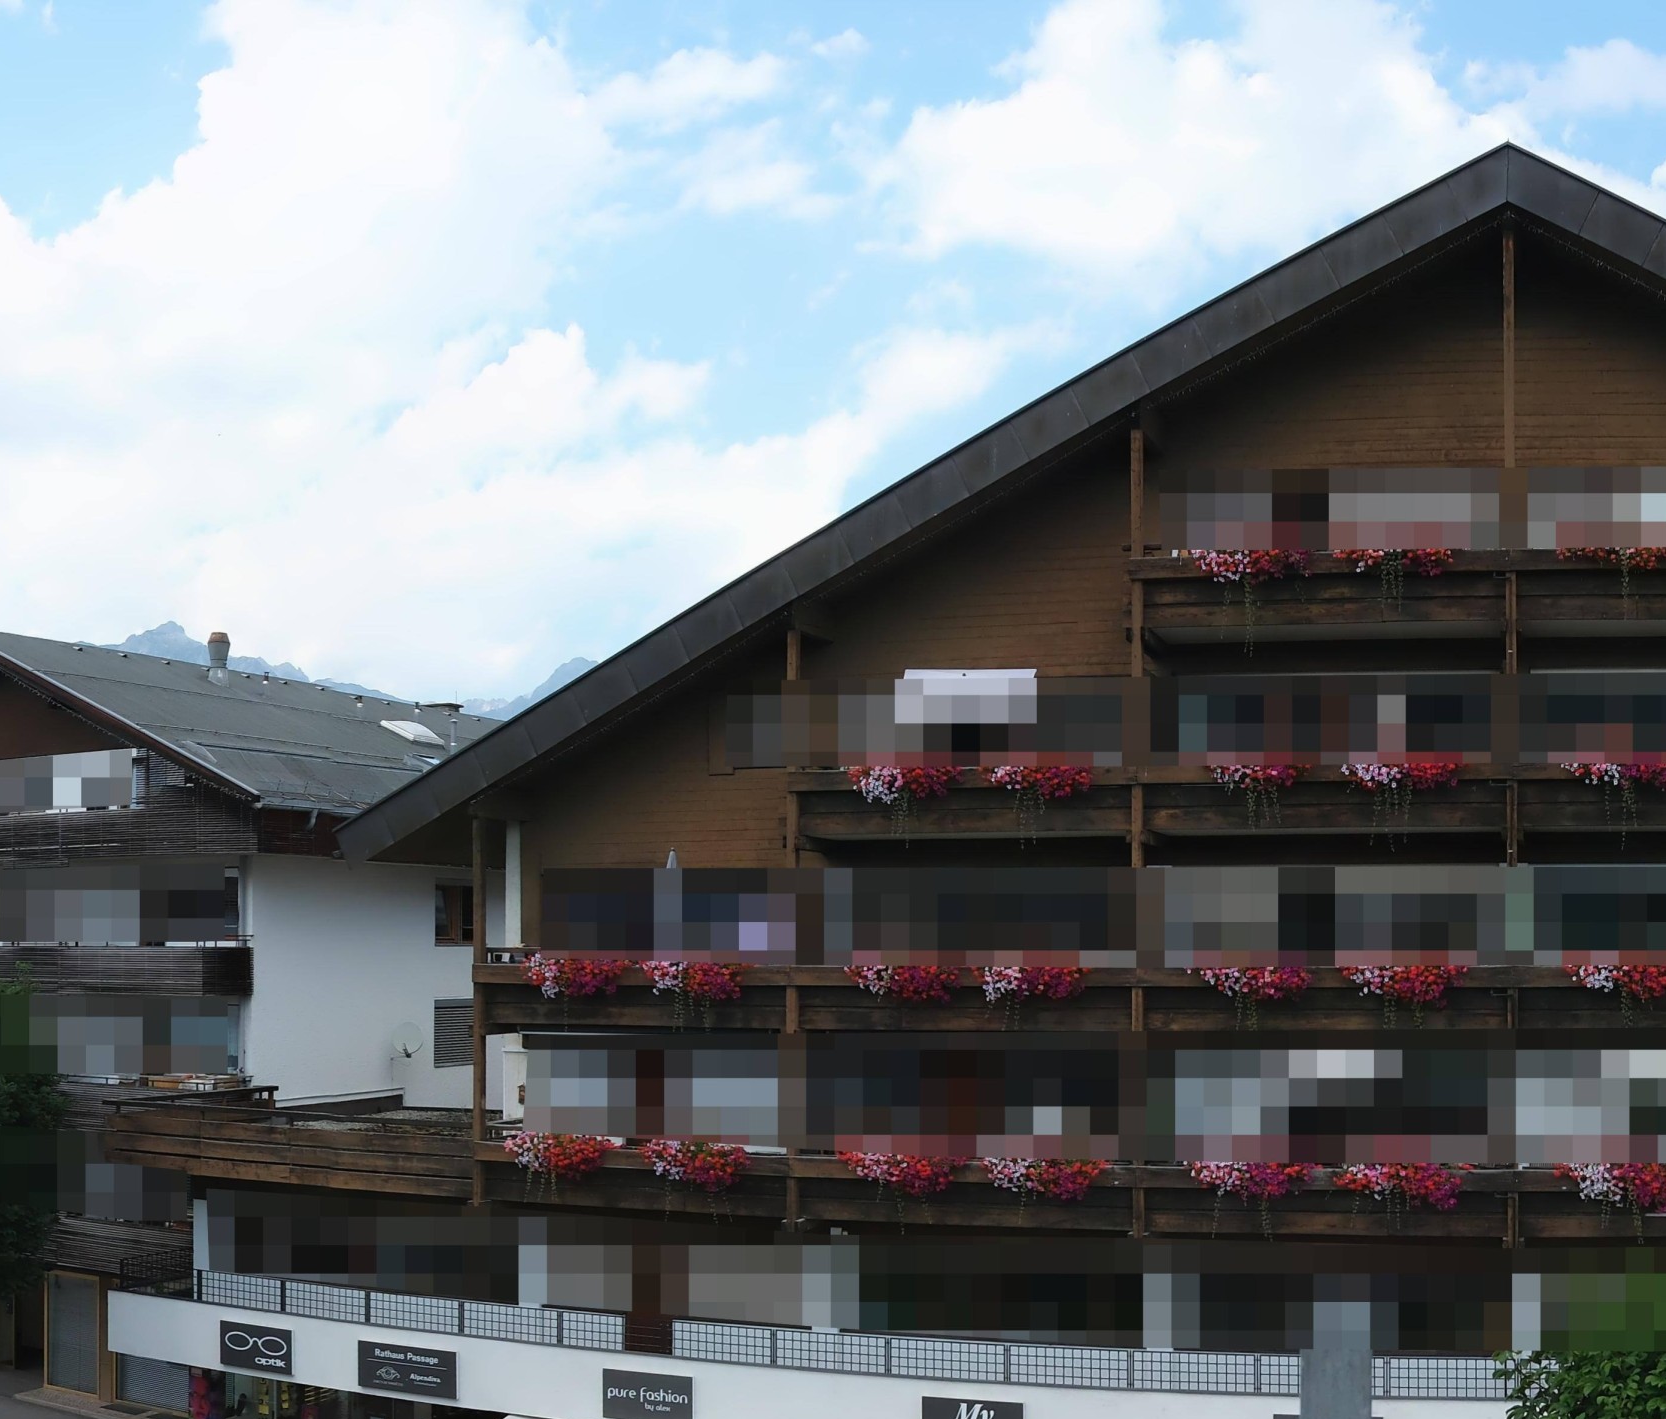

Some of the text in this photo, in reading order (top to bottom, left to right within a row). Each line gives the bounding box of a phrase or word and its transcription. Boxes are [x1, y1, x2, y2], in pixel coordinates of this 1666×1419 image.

[374, 1348, 440, 1365] Rathaus Passage
[254, 1357, 287, 1369] optik
[409, 1373, 442, 1384] Alpendiva
[607, 1387, 688, 1404] pure fashion
[644, 1402, 671, 1412] by alex
